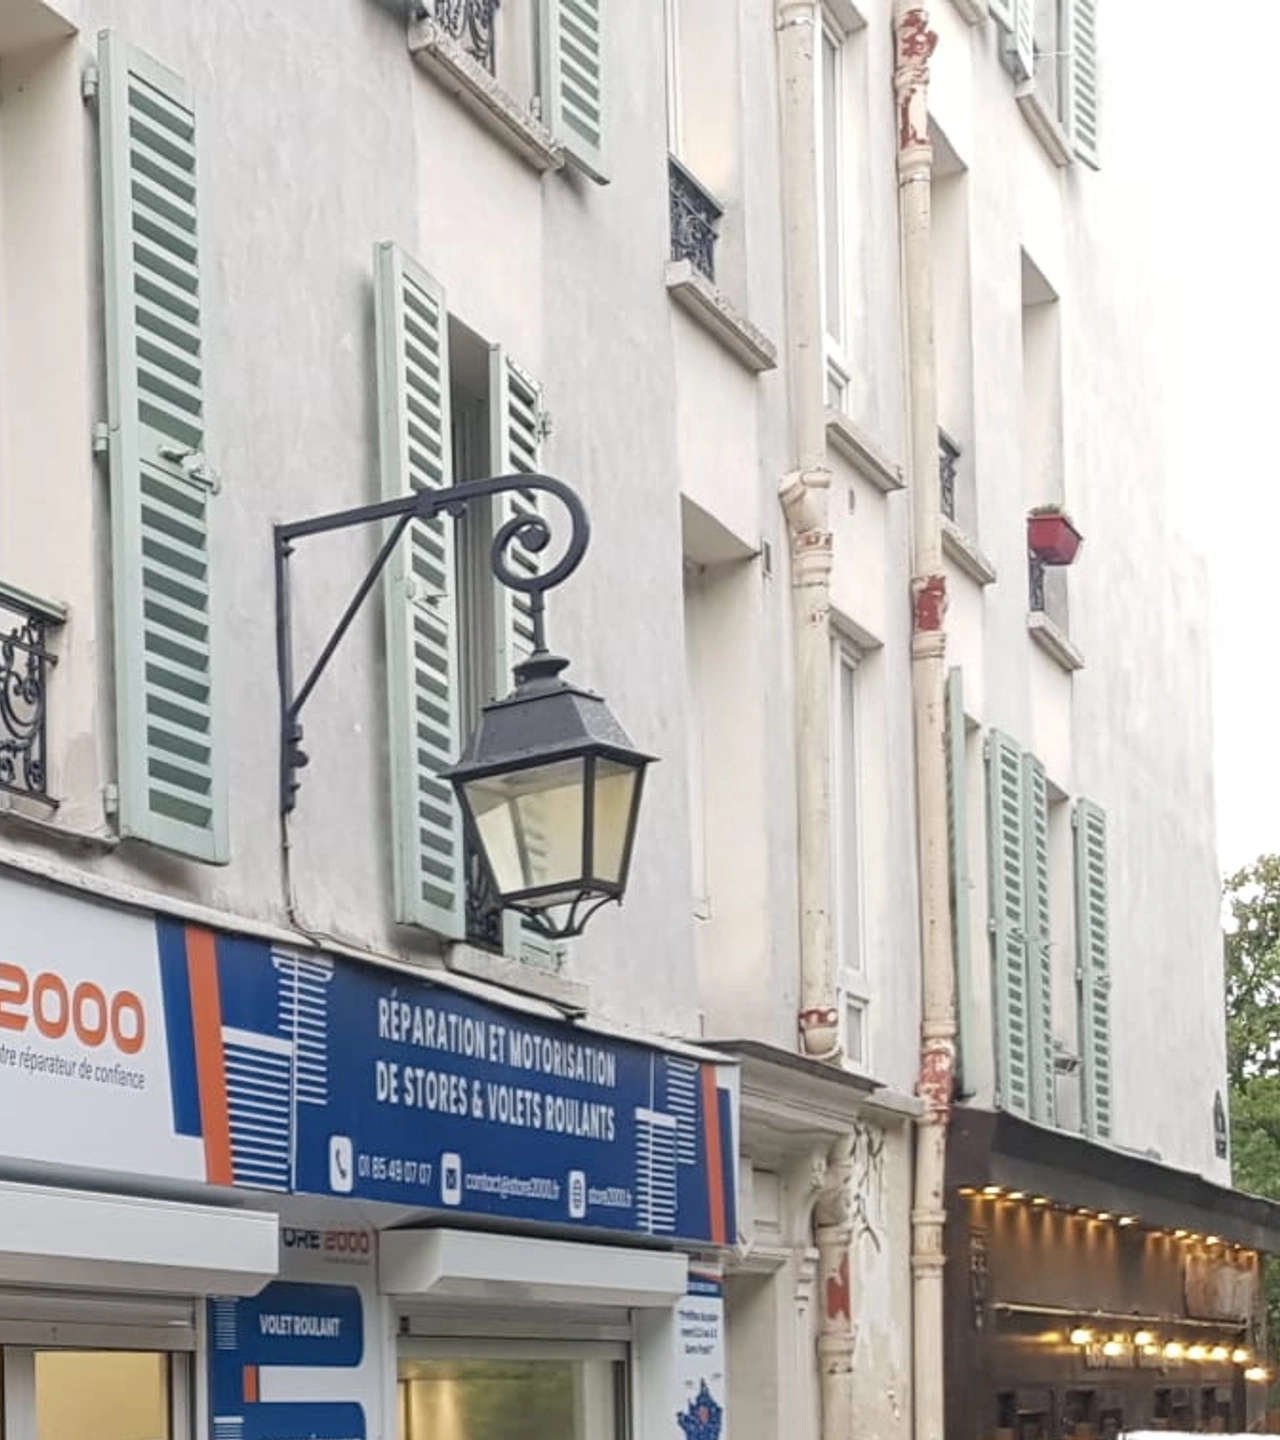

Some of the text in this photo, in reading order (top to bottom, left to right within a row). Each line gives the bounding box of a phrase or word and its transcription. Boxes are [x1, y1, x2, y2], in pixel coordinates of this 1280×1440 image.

[378, 988, 616, 1088] RÉPARATION ET MOTORISATION
[19, 1046, 77, 1077] réparateur
[78, 1057, 93, 1080] de
[94, 1064, 146, 1090] confiance
[376, 1061, 615, 1142] DE STORES & VOLETS ROULANTS
[358, 1154, 432, 1186] 01 85 49 07 07
[282, 1228, 370, 1254] ORE 2000
[259, 1314, 341, 1337] VOLET ROULANT
